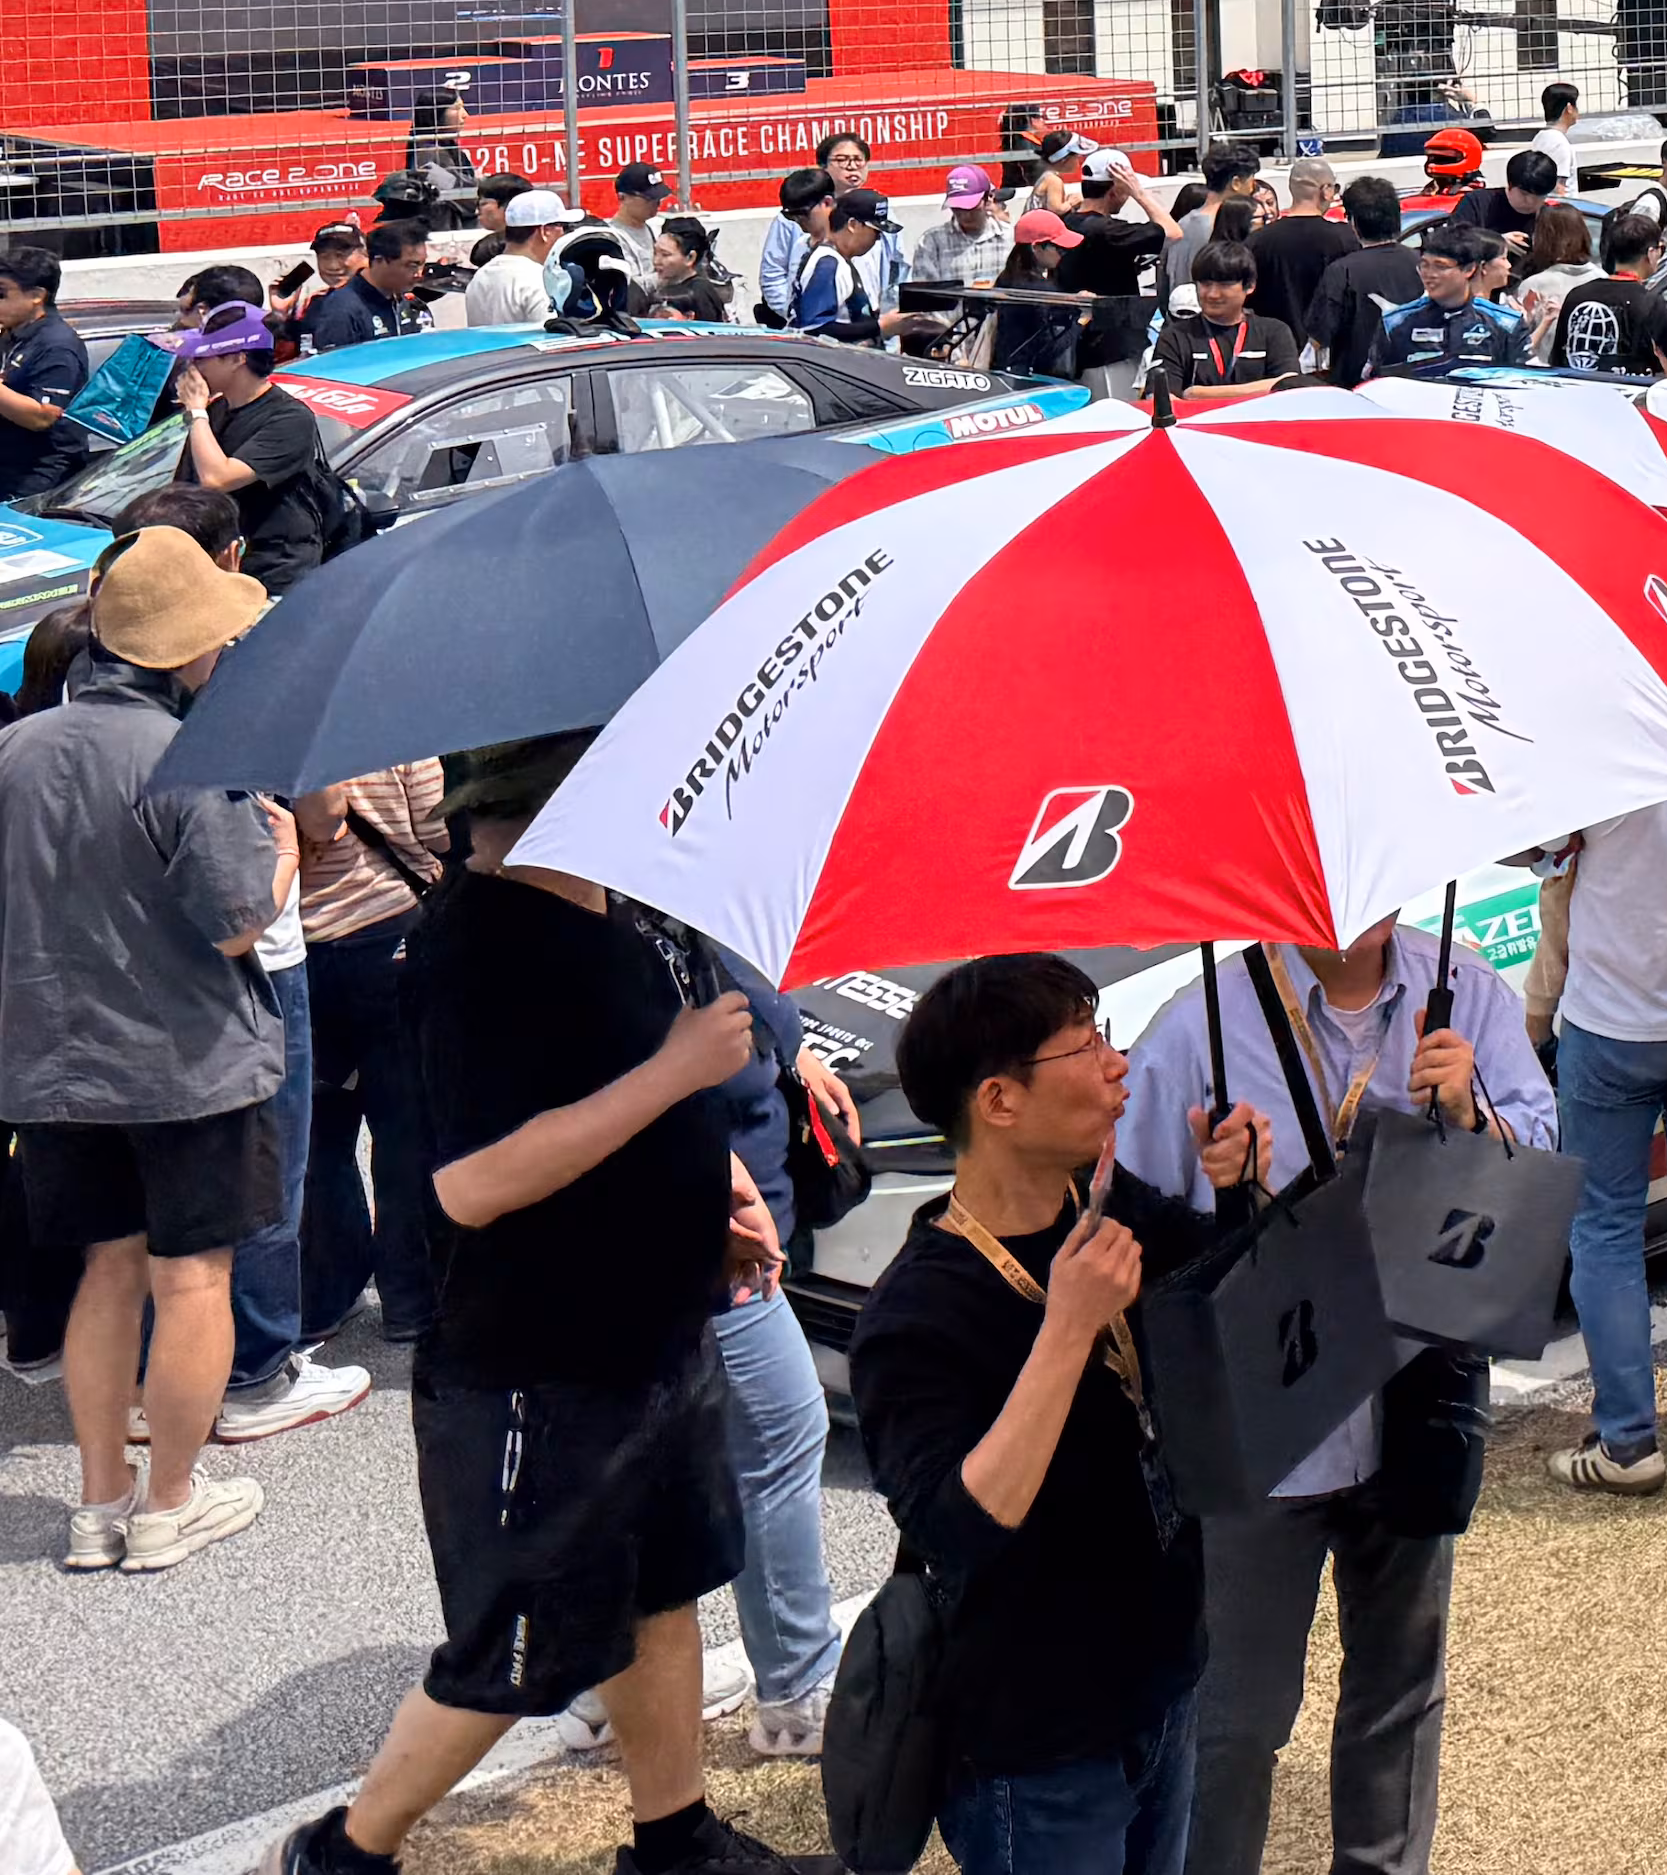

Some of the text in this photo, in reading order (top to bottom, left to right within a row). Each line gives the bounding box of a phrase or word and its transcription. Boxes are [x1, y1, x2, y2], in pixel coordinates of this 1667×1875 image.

[598, 48, 614, 70] 1
[443, 72, 472, 91] 2
[725, 72, 750, 91] 3
[904, 367, 990, 391] ZIGATO
[951, 405, 1042, 439] MOTUL
[1303, 536, 1496, 795] BRIDGESTONE
[659, 547, 895, 837] BRIDGESTONE
